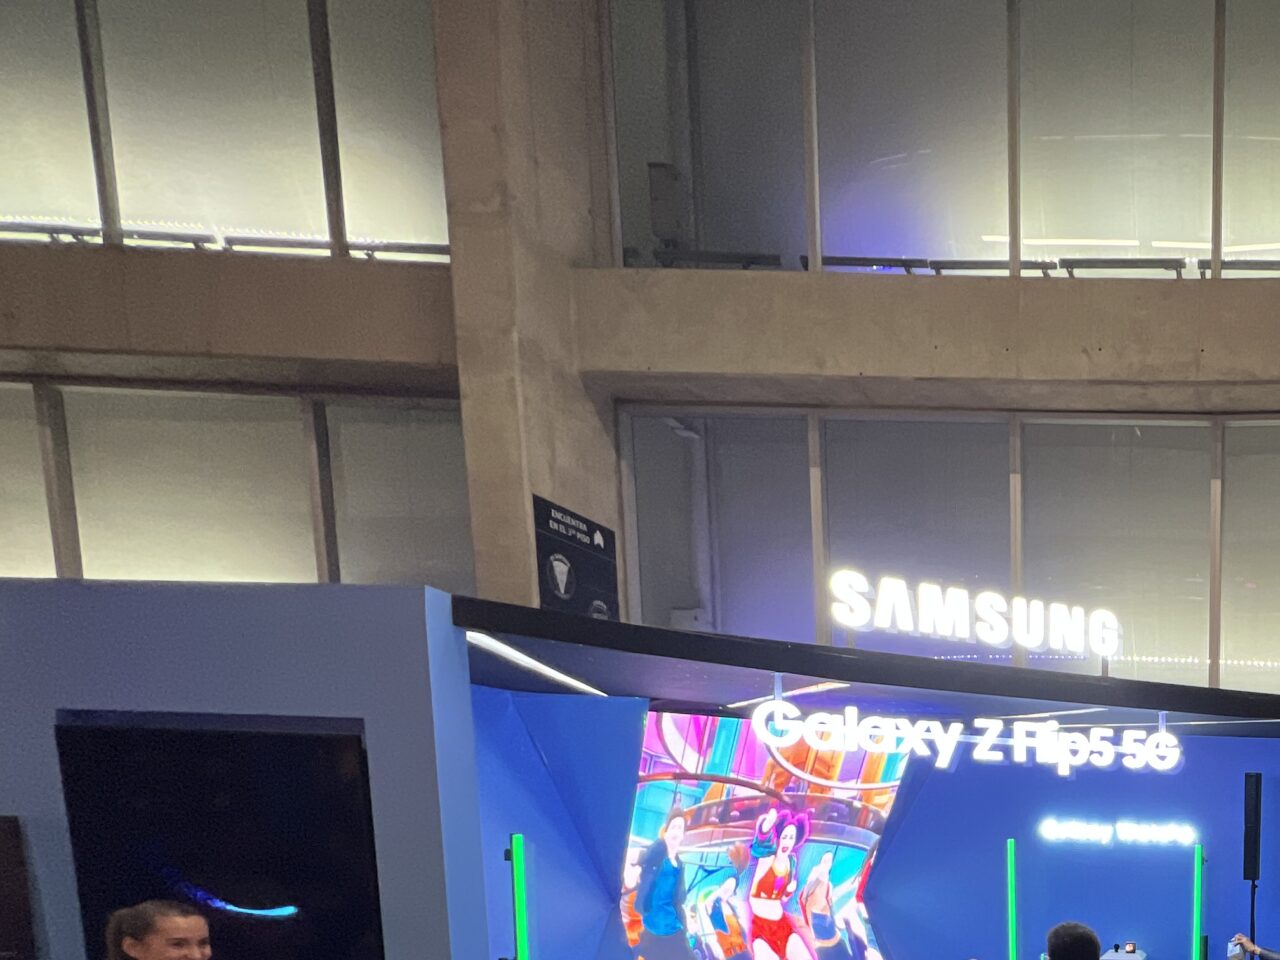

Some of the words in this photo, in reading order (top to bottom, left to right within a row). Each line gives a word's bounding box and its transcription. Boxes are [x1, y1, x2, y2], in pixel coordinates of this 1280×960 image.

[549, 519, 559, 530] EN
[830, 569, 1121, 656] SAMSUNG
[752, 700, 964, 768] Galaxy
[973, 718, 1004, 761] Z
[1013, 720, 1116, 776] Flip5
[1122, 729, 1181, 771] 5G
